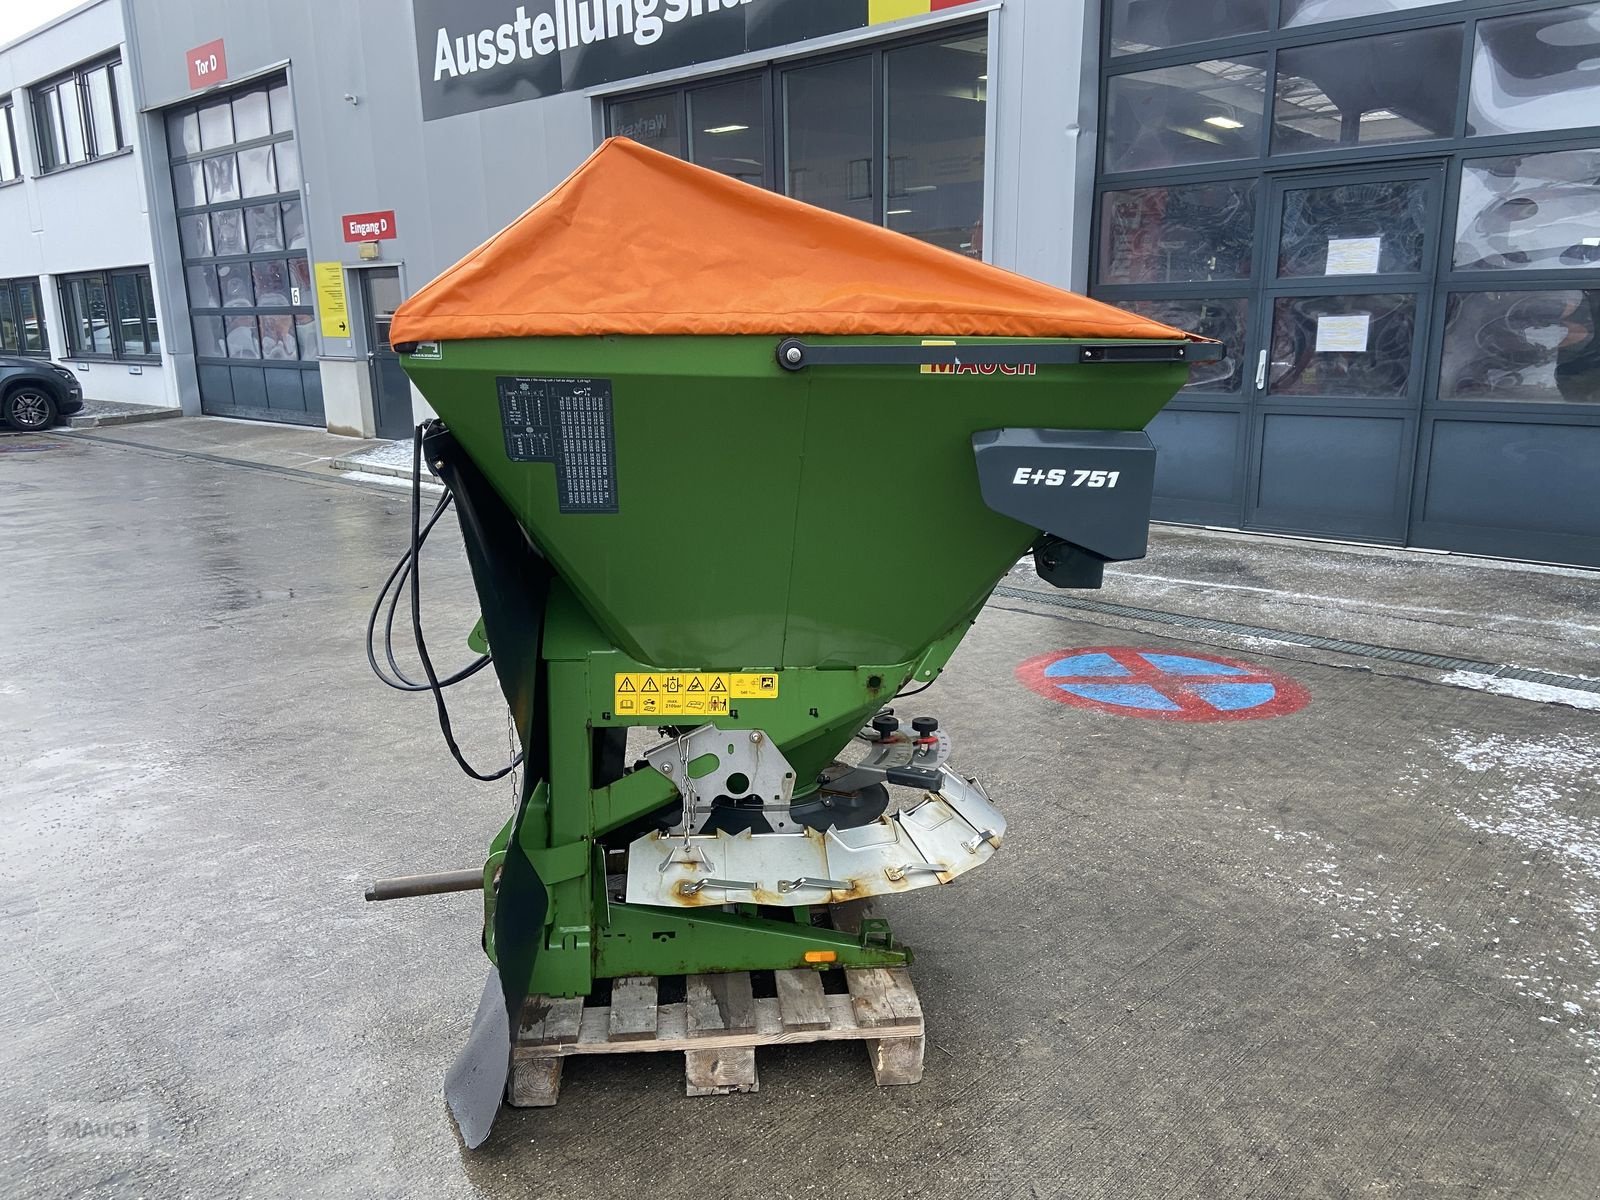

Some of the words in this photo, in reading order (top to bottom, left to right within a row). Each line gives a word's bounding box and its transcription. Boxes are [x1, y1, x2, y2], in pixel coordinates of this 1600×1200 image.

[434, 0, 751, 81] Ausstellungs
[195, 59, 209, 76] Tor
[210, 54, 217, 71] D
[350, 221, 380, 236] Eingang
[380, 218, 387, 231] D
[293, 289, 299, 304] 6
[1012, 467, 1067, 486] E+S
[1071, 469, 1120, 488] 751
